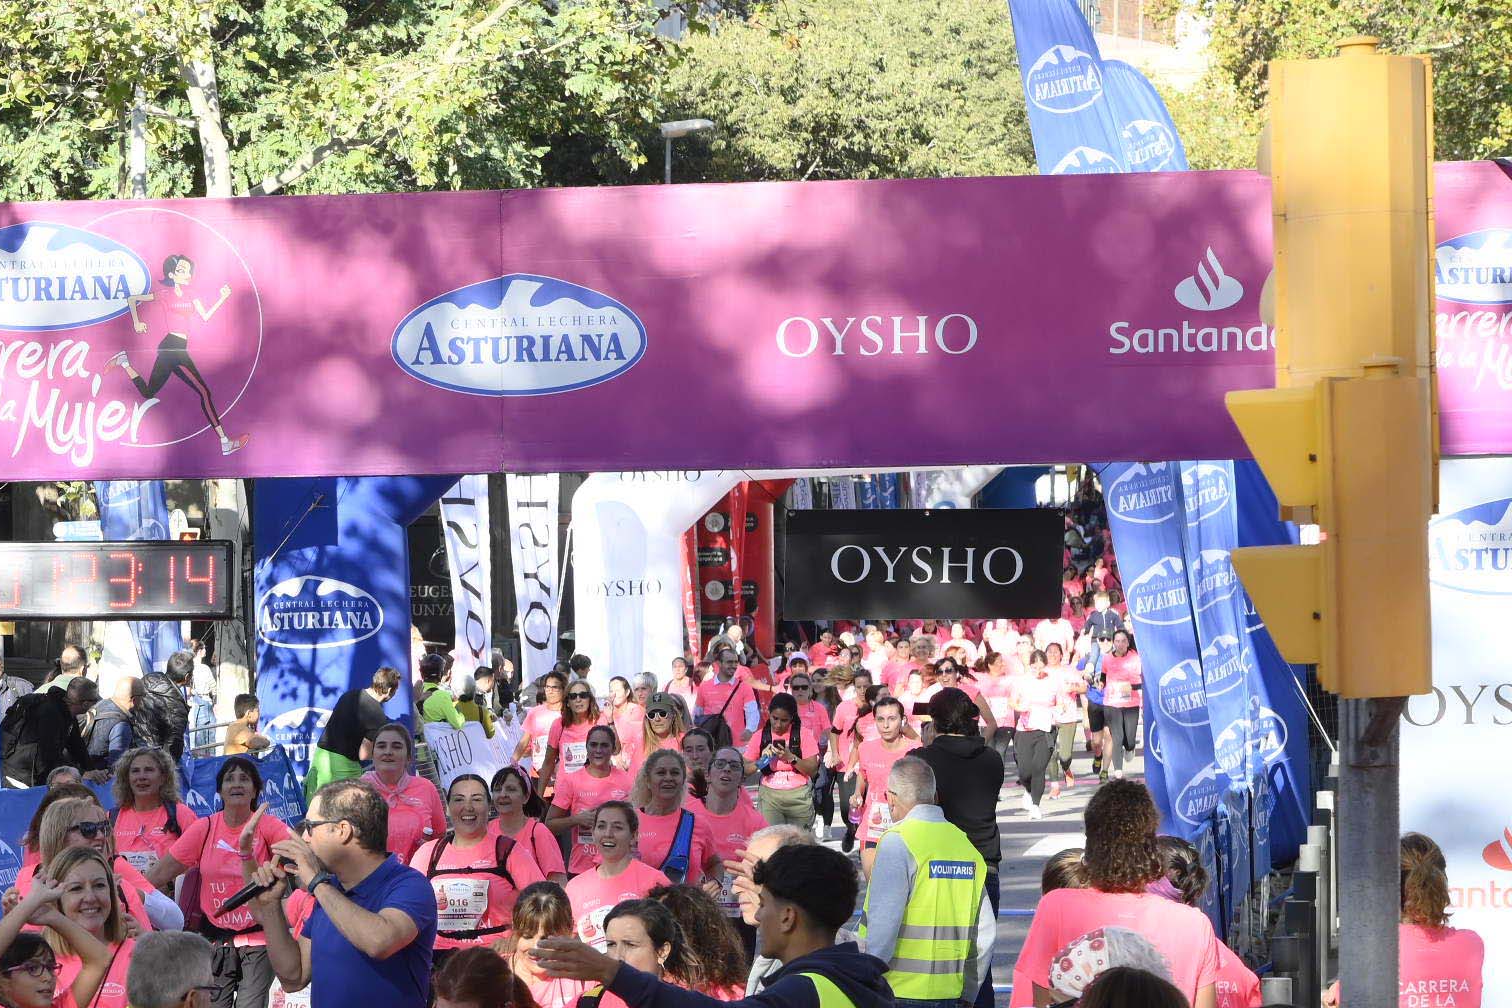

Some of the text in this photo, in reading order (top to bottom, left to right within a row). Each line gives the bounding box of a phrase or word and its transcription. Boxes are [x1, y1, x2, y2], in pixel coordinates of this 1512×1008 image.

[449, 314, 619, 330] CENTRAL LECHERA
[775, 313, 979, 358] OYSHO
[1108, 319, 1275, 354] Santand
[410, 321, 627, 366] ASTURIANA
[11, 370, 164, 467] Mujer
[830, 544, 1024, 586] OYSHO
[260, 605, 374, 632] ASTURIANA
[272, 599, 370, 610] CENTRAL LECHERA
[1401, 683, 1512, 727] OYS
[210, 883, 226, 894] TU
[450, 898, 469, 907] 016
[1408, 993, 1456, 1008] DE LA
